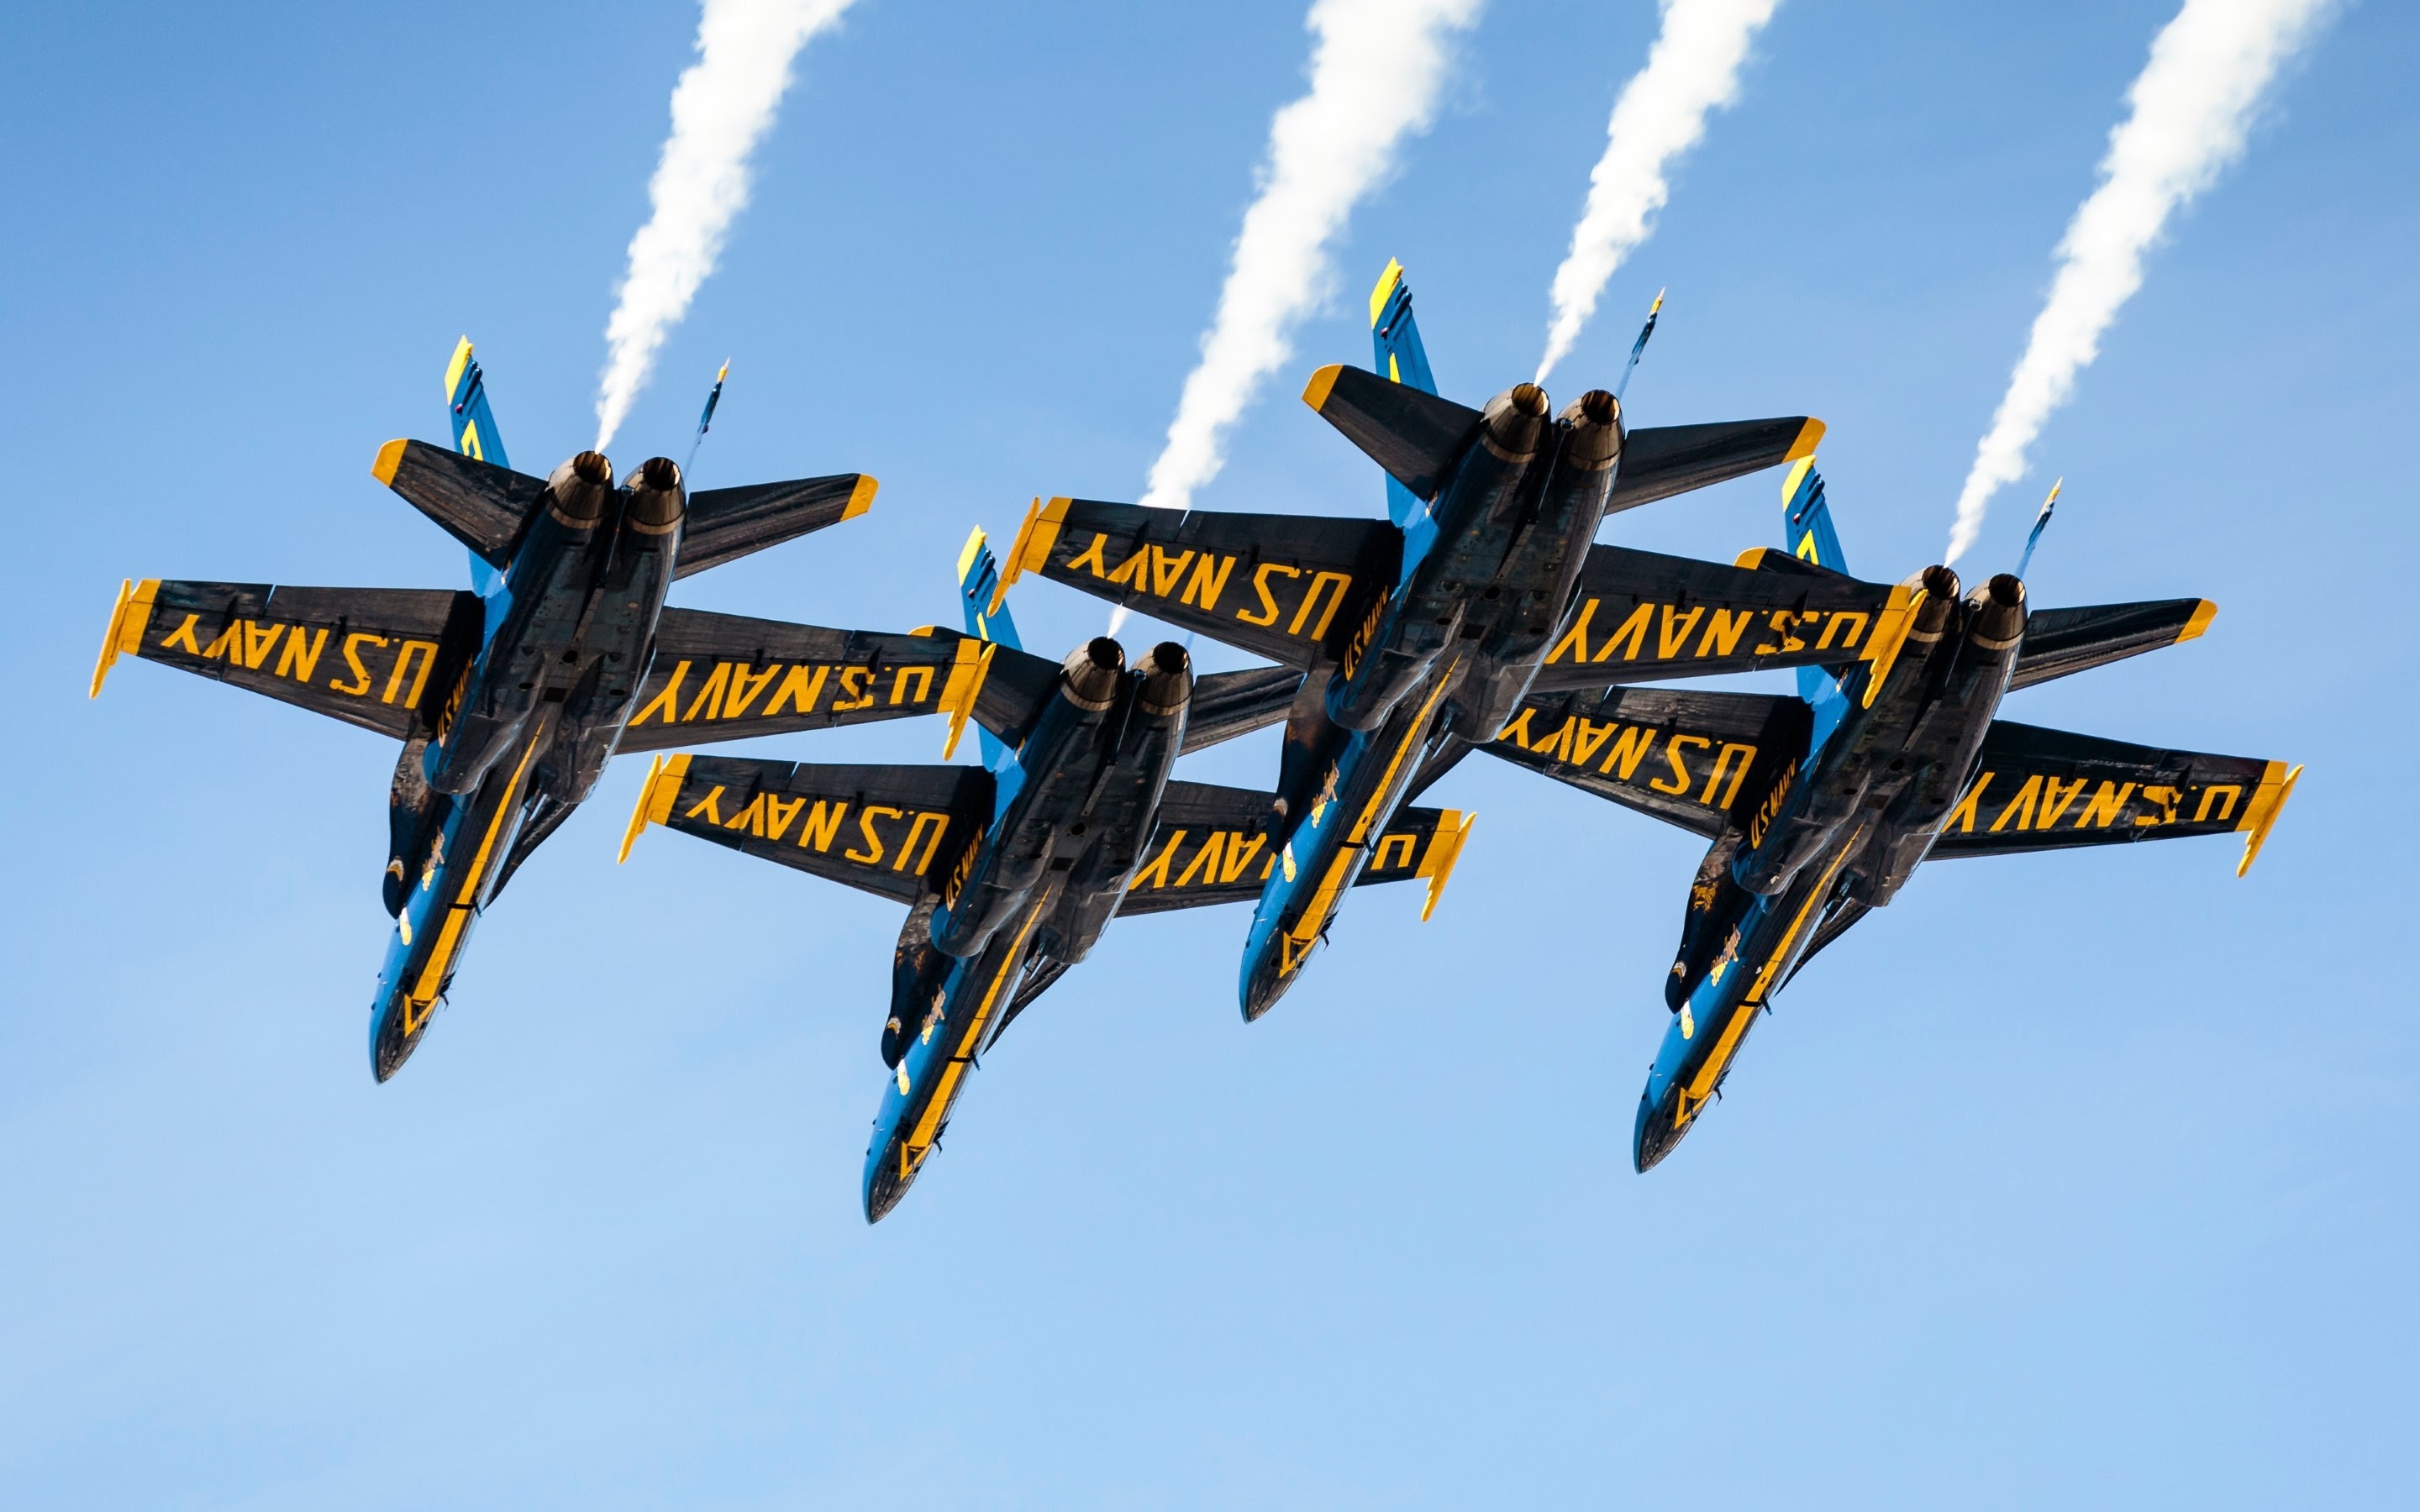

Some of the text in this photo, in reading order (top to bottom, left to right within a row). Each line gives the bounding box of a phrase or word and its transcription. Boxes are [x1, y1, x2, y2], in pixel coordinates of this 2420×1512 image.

[1066, 533, 1237, 612] NAVY
[160, 613, 329, 683] NAVY
[1544, 598, 1754, 664] NAVY
[628, 660, 831, 727] NAVY
[1497, 707, 1657, 780] NAVY
[686, 785, 849, 853] NAVY
[1942, 771, 2137, 833] NAVY
[1128, 829, 1277, 890] AVY
